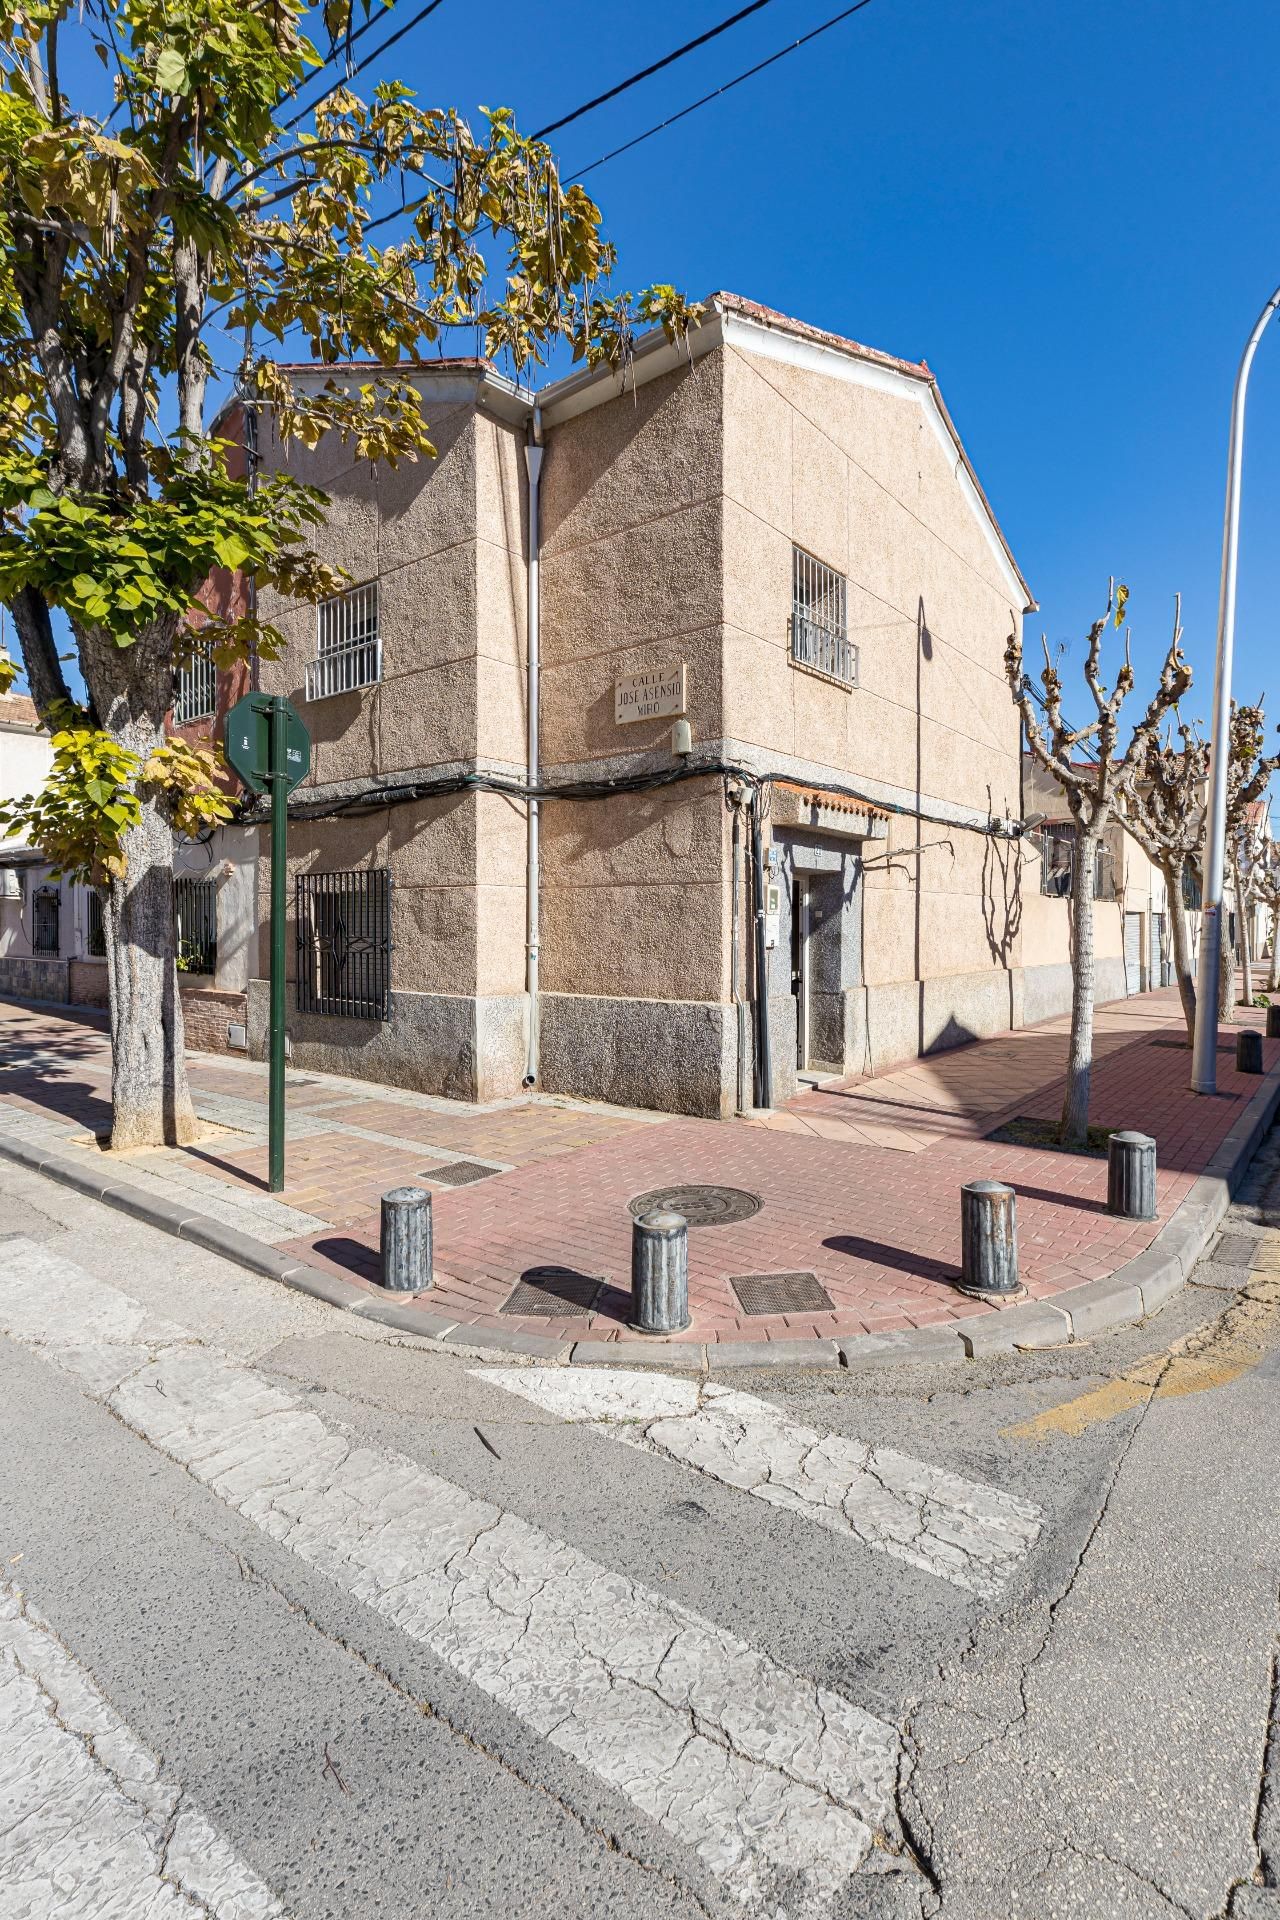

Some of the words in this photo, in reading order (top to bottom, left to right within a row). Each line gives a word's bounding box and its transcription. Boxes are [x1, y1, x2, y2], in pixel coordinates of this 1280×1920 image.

[632, 672, 664, 687] CALLE
[618, 690, 639, 706] JOSE
[643, 682, 680, 701] ASENSIO
